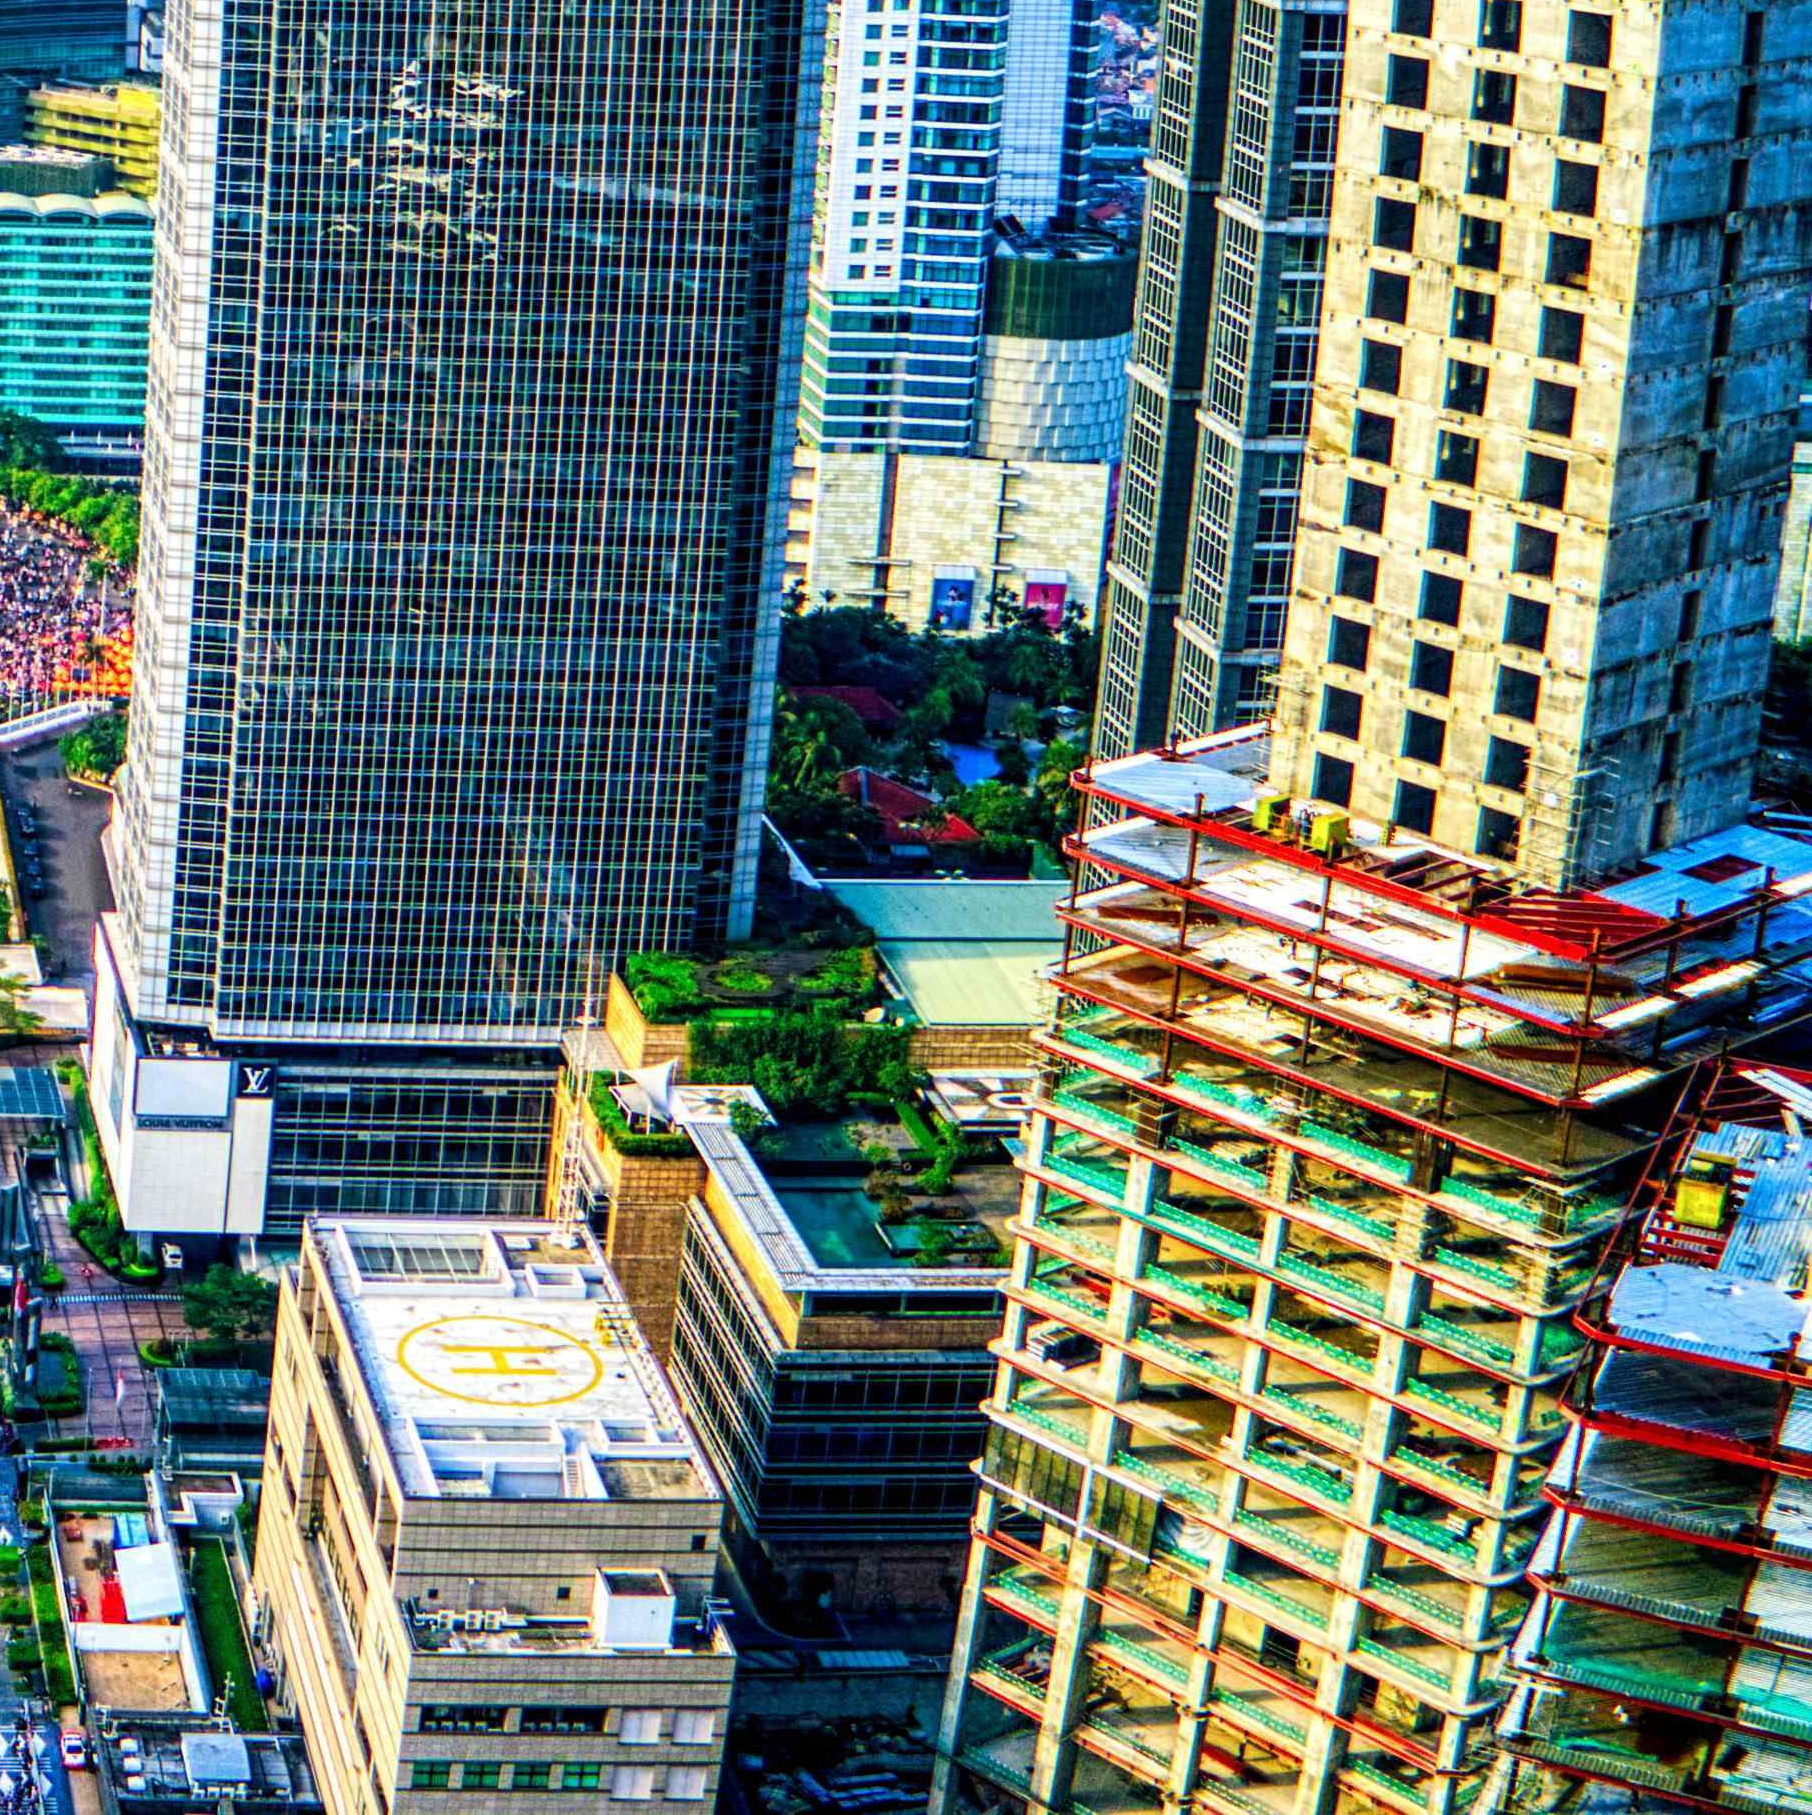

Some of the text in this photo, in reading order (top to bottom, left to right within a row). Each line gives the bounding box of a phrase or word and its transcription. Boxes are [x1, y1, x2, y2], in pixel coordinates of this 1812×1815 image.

[138, 1118, 224, 1129] LOUIS VUITTON
[441, 1345, 558, 1375] H
